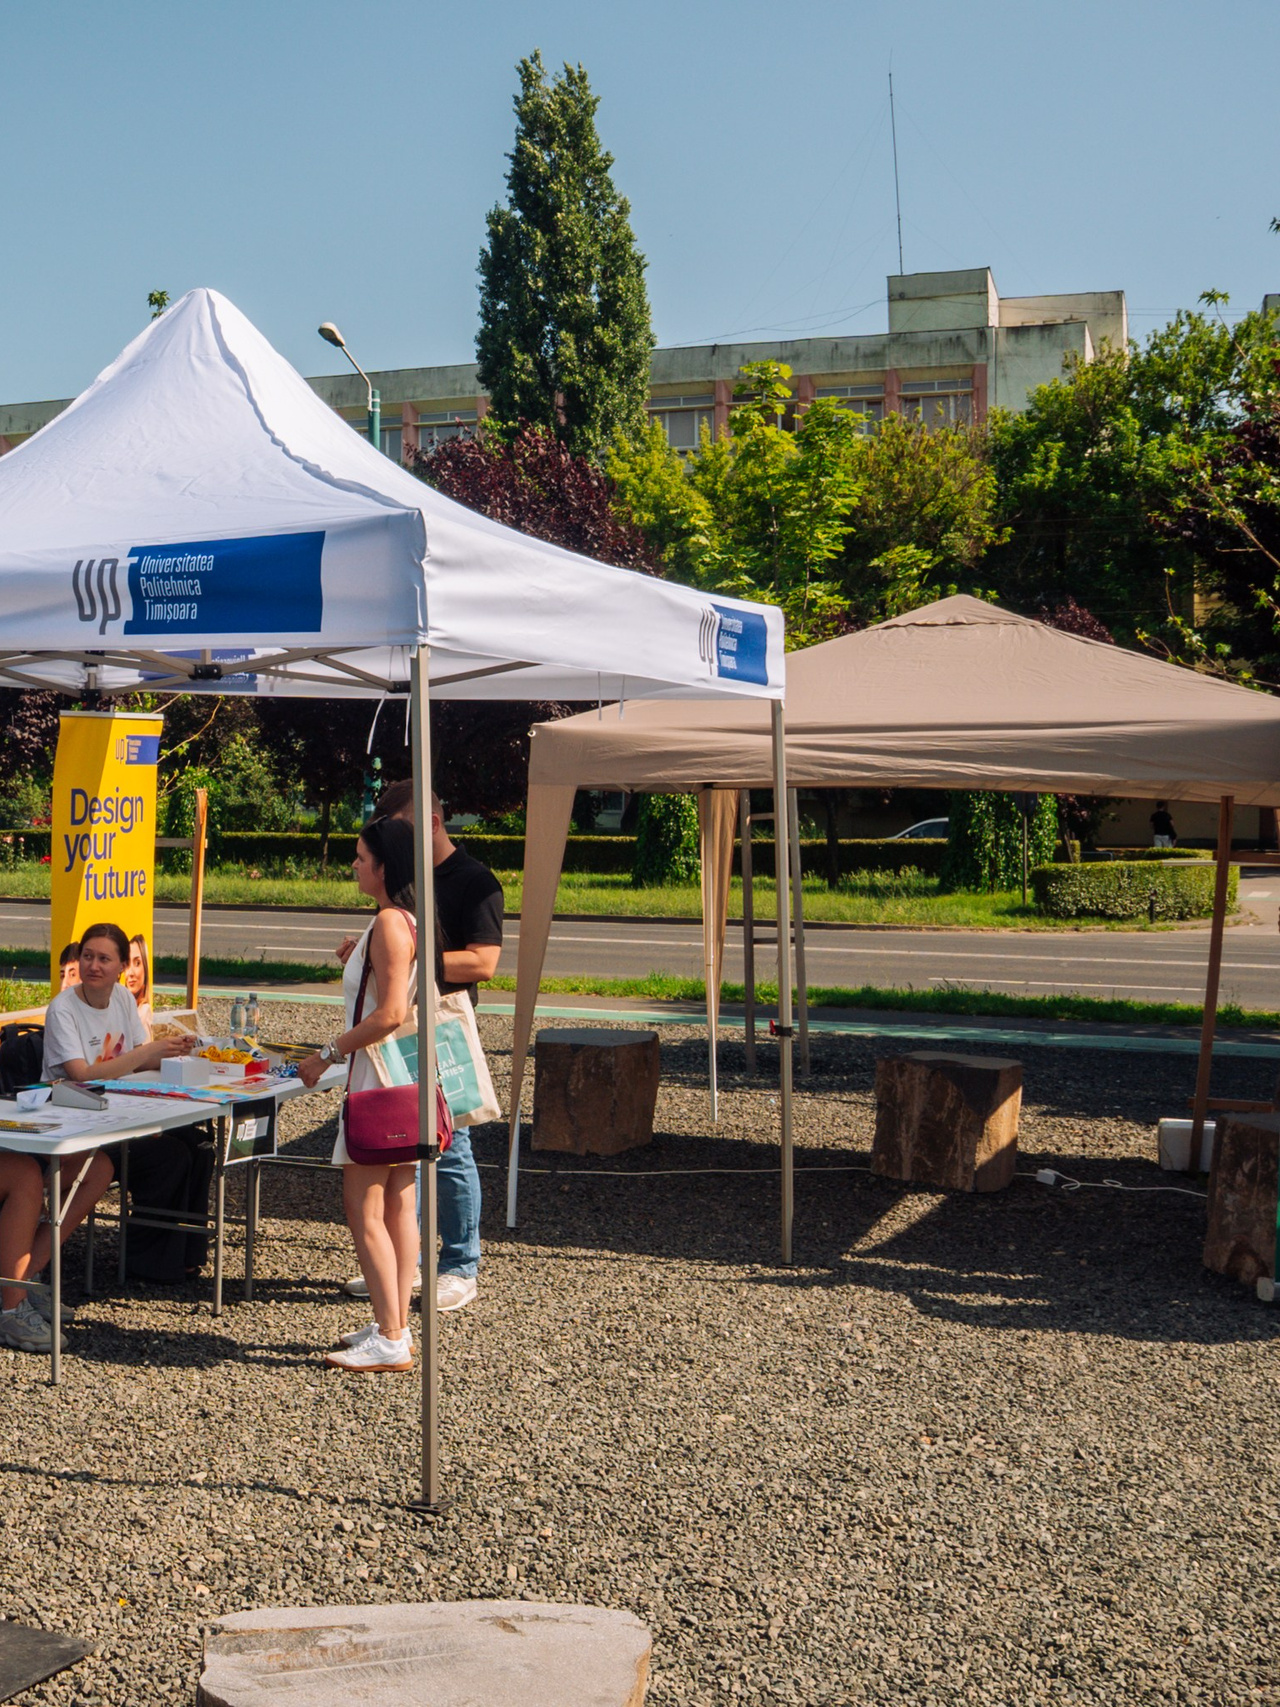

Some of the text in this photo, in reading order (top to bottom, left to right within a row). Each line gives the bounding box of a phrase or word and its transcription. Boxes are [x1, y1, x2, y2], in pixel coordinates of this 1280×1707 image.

[140, 553, 215, 575] Universitatea
[139, 576, 202, 598] Politehnica
[144, 600, 198, 624] Timișoara
[70, 786, 144, 834] Design
[64, 832, 117, 873] your
[84, 863, 147, 901] future
